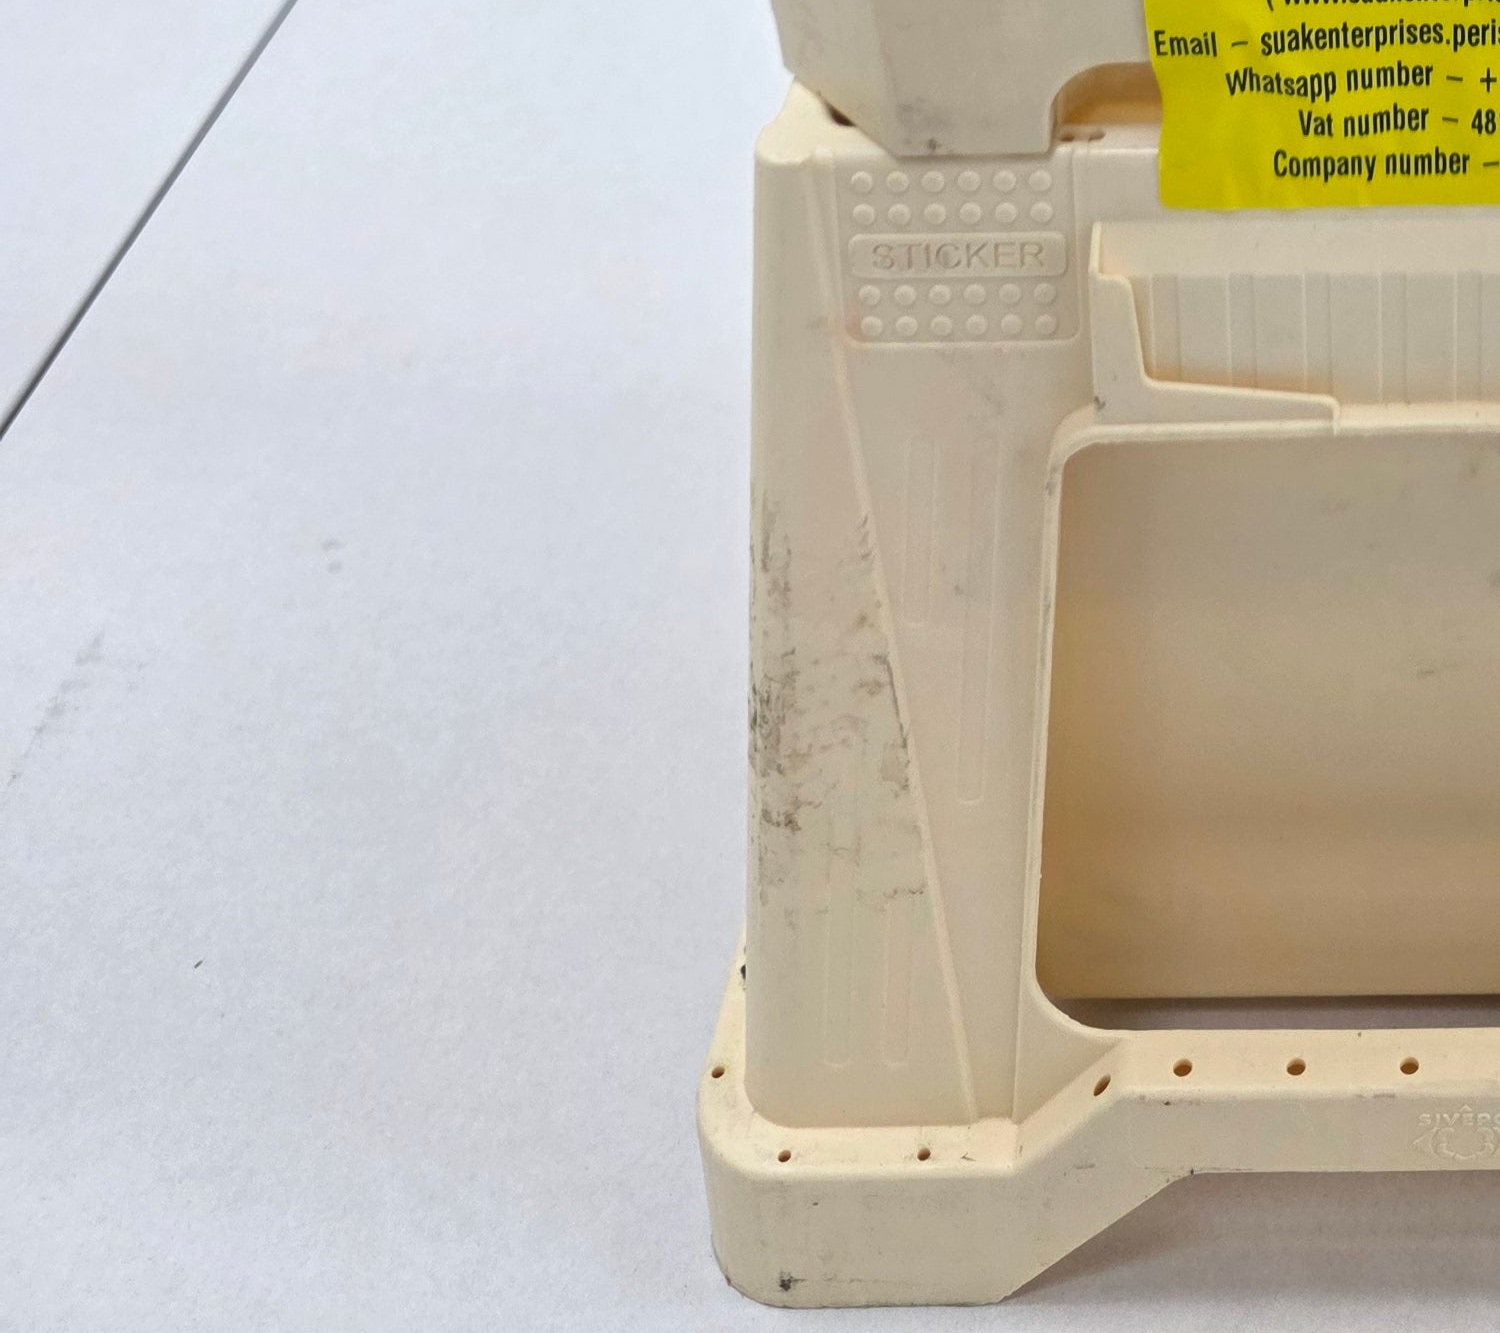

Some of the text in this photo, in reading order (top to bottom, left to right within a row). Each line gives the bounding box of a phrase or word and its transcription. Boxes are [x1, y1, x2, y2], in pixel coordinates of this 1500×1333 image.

[1153, 30, 1218, 58] Email
[1225, 66, 1337, 104] Whatsapp
[1346, 59, 1434, 93] number
[1298, 109, 1334, 137] Vat
[1343, 102, 1430, 138] number
[1273, 148, 1377, 184] Company
[1385, 145, 1470, 177] number
[871, 240, 1045, 271] STICKER
